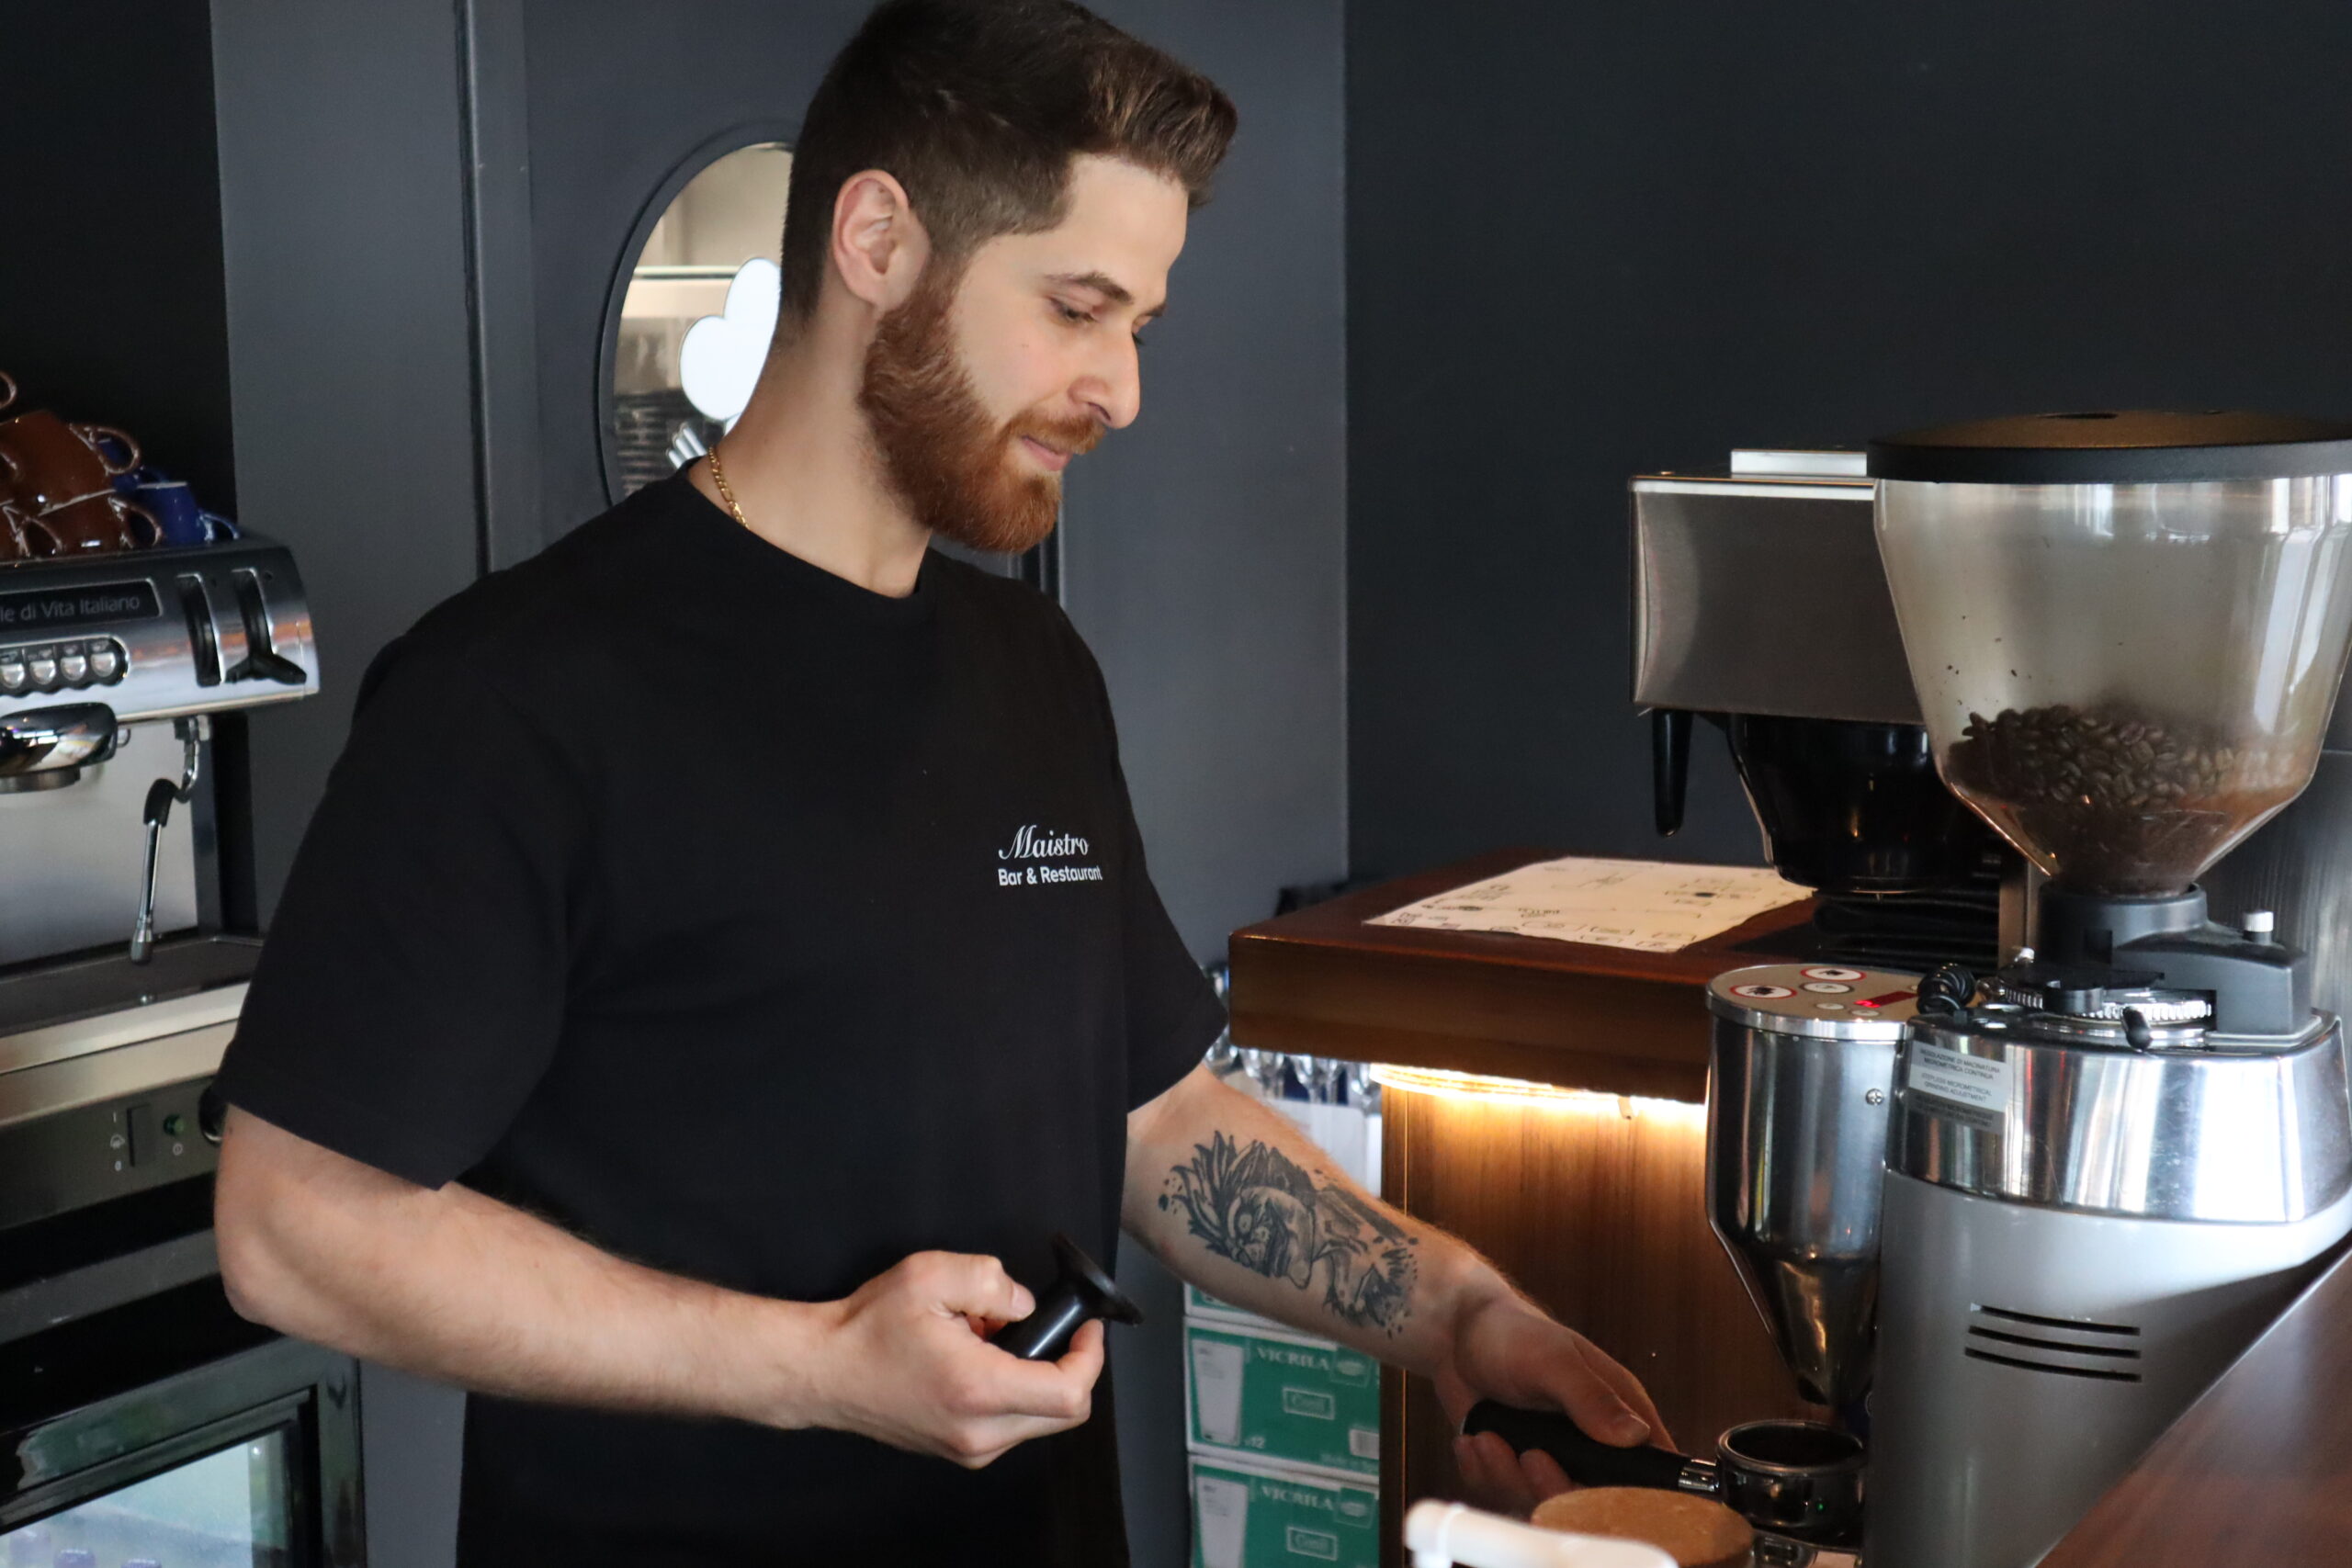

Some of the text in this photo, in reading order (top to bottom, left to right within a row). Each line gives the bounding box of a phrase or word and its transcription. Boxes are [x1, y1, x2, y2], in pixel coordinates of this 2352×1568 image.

[20, 603, 36, 621] di
[40, 600, 74, 618] Vita
[80, 596, 141, 615] Italiano
[998, 824, 1090, 860] Maistro
[998, 864, 1103, 886] Bar & Restaurant
[1257, 1347, 1329, 1371] VICRILA
[1261, 1485, 1334, 1511] VICRILA
